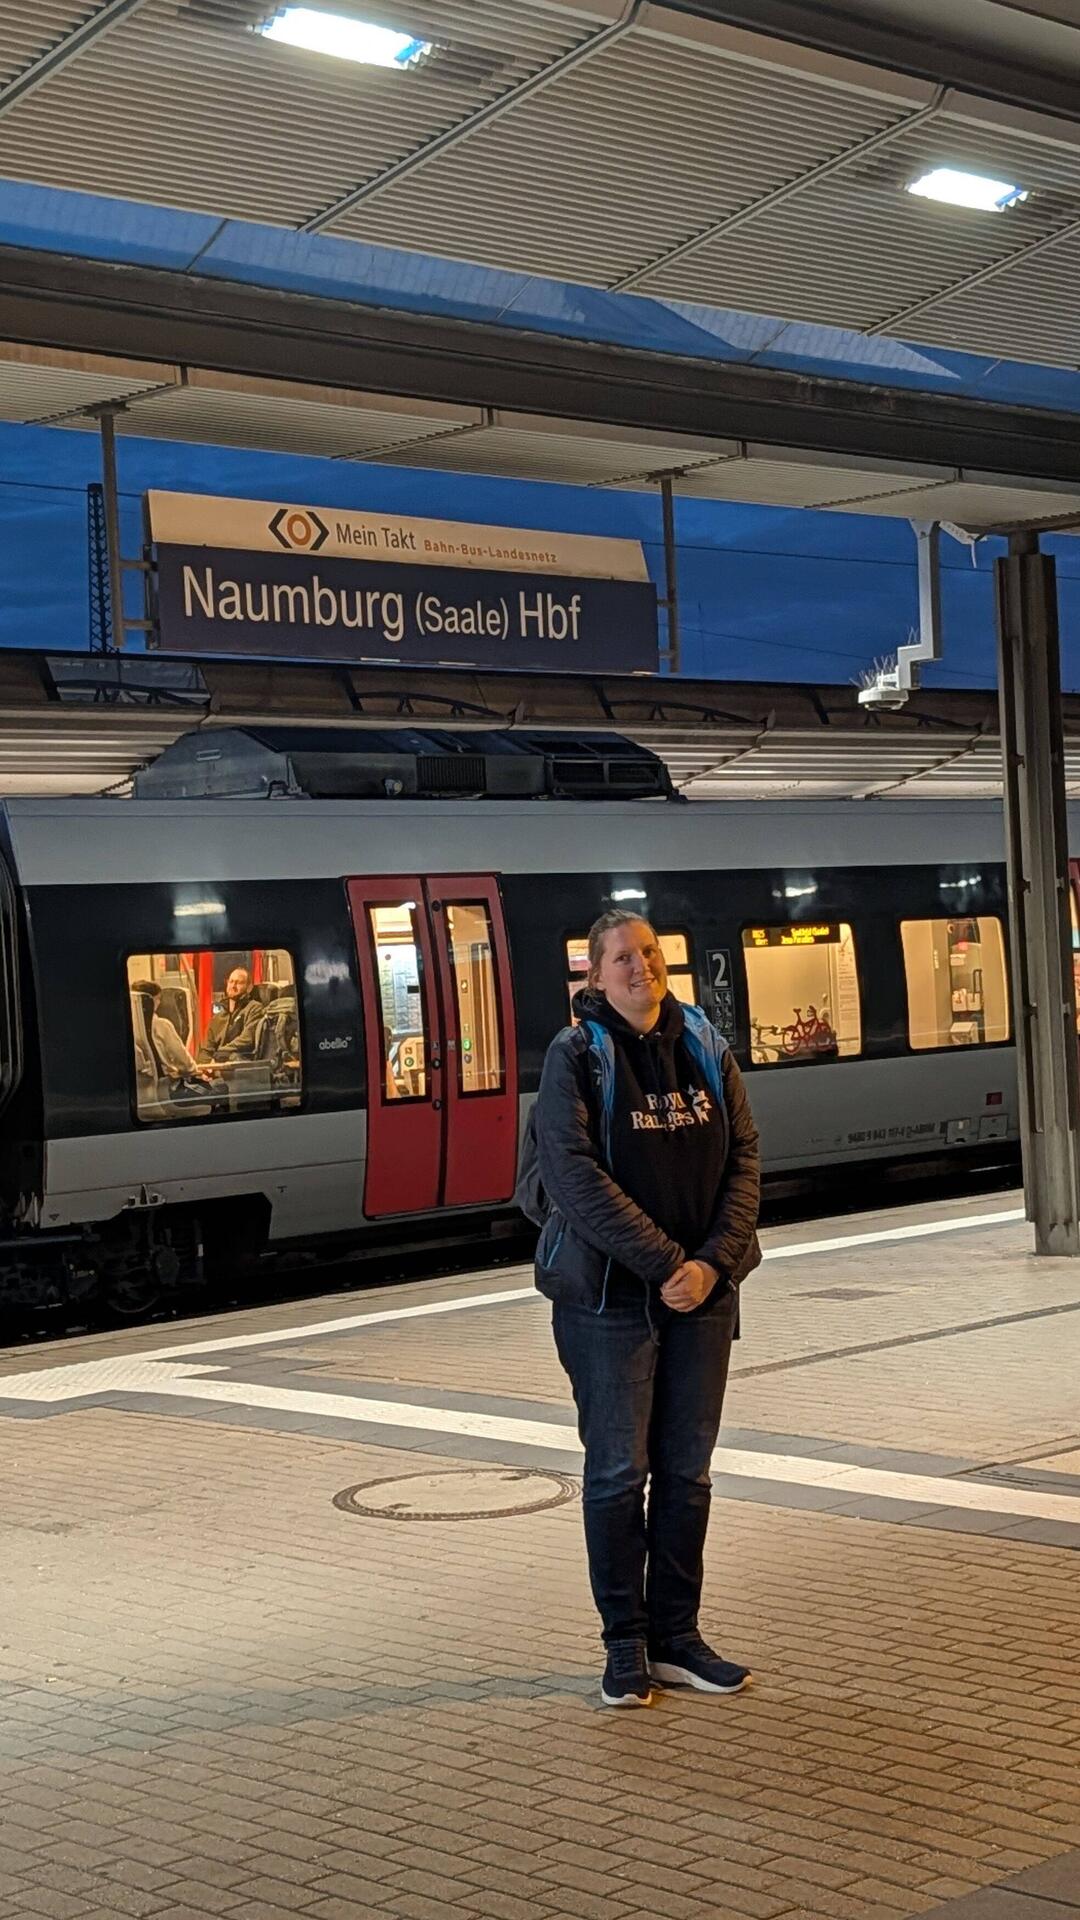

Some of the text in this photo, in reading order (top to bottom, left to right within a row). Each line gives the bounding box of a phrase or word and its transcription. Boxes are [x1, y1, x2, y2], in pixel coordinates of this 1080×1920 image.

[336, 523, 416, 550] Mein Takt
[424, 539, 557, 563] Bahn-Bus-Landesnetz
[183, 565, 581, 642] Naumburg (Saale) Hbf
[712, 953, 729, 987] 2
[645, 1092, 687, 1111] Royl
